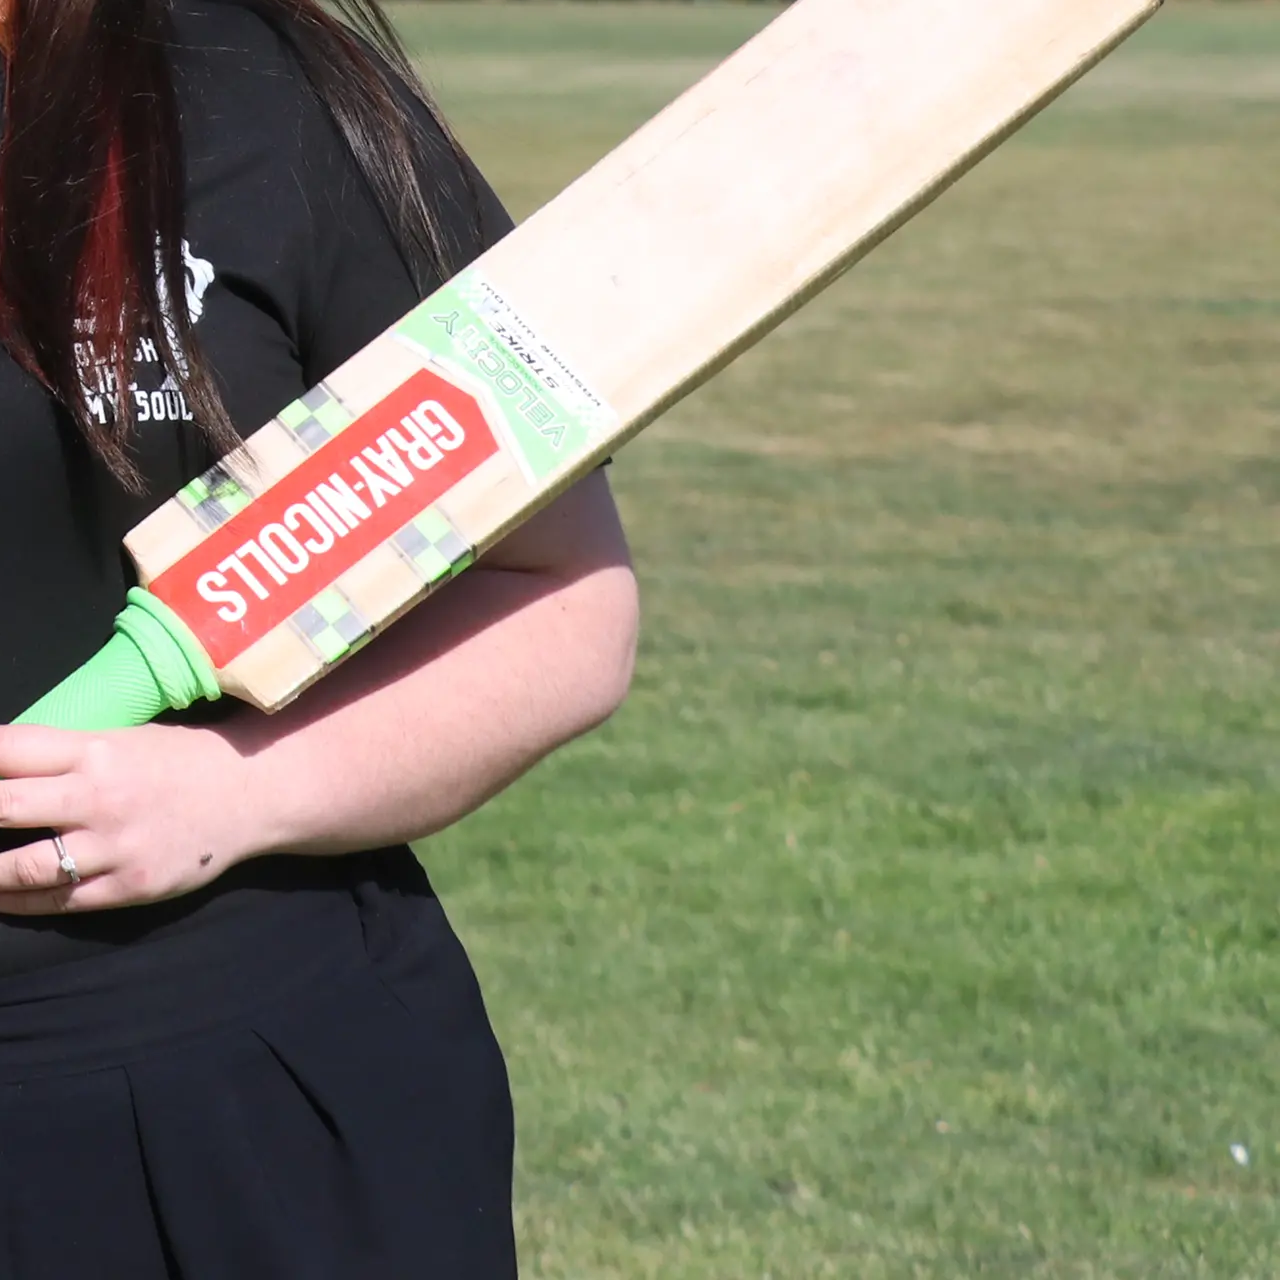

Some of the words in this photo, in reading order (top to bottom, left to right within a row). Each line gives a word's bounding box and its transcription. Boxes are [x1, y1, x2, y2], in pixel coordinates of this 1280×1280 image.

[134, 390, 194, 422] SOUL
[432, 311, 564, 448] VELOCITY
[488, 321, 559, 389] STRIKE
[195, 398, 466, 623] GRAY-NICOLLS
